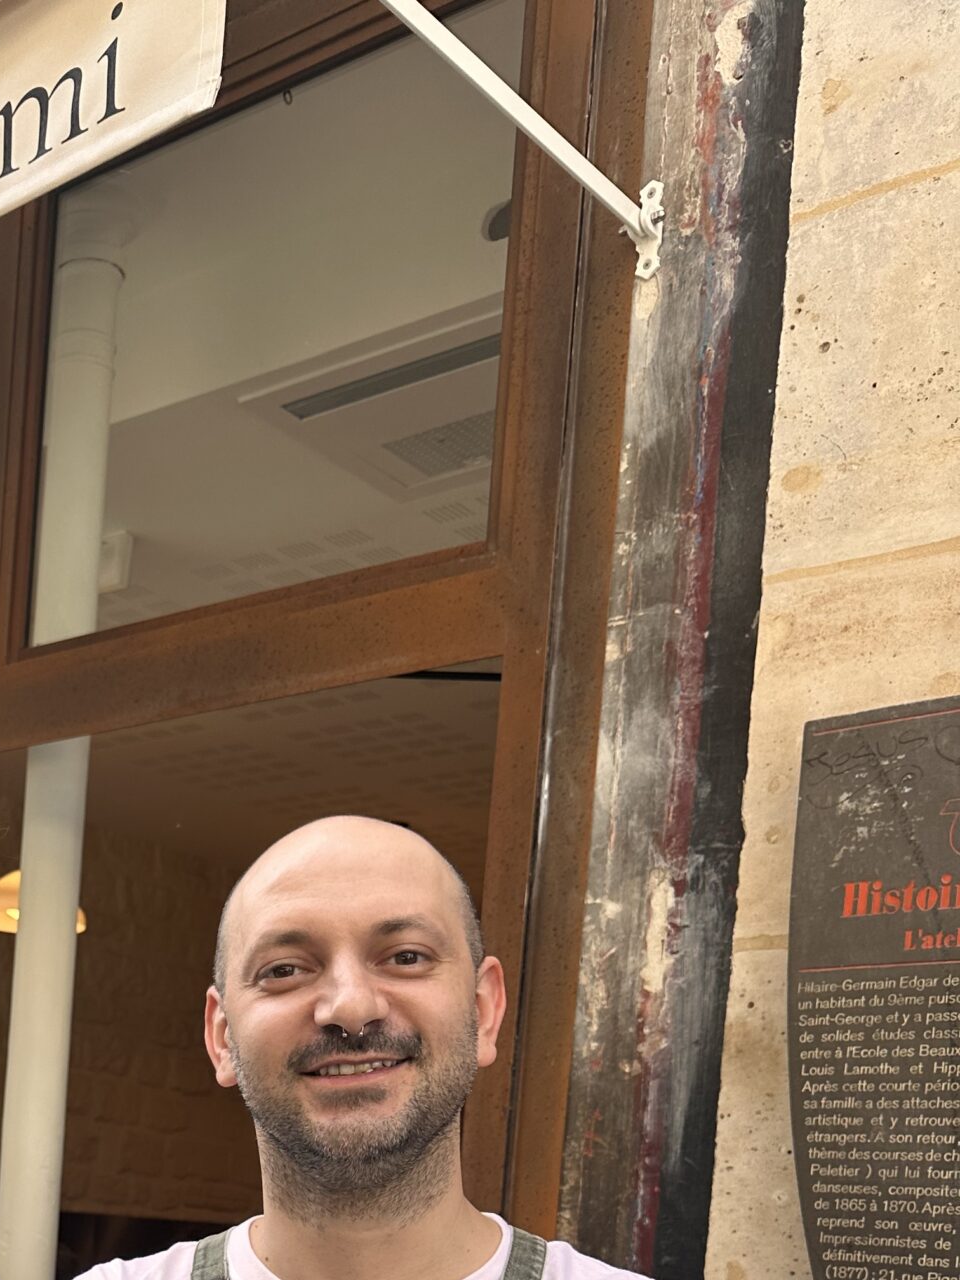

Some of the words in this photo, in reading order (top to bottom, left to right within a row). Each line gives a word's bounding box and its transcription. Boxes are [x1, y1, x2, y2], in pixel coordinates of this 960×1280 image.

[797, 978, 896, 994] Hilaire-Germain
[899, 975, 938, 991] Edgar
[943, 973, 960, 987] de
[798, 1002, 812, 1010] un
[815, 995, 866, 1010] habitant
[869, 995, 885, 1007] du
[887, 993, 925, 1006] 9ème
[798, 1012, 882, 1027] Saint-George
[886, 1012, 899, 1023] et
[902, 1013, 910, 1026] y
[913, 1013, 922, 1022] a
[799, 1032, 815, 1043] de
[821, 1030, 865, 1043] solides
[872, 1028, 916, 1041] études
[800, 1047, 831, 1060] entre
[835, 1046, 843, 1059] à
[892, 1046, 915, 1057] des
[801, 1064, 835, 1076] Louis
[844, 1062, 900, 1075] Lamothe
[909, 1062, 924, 1074] et
[801, 1080, 839, 1096] Après
[842, 1080, 875, 1092] cette
[878, 1080, 921, 1092] courte
[803, 1100, 818, 1109] sa
[820, 1097, 863, 1109] famille
[865, 1099, 873, 1109] a
[876, 1097, 900, 1109] des
[805, 1114, 864, 1129] artistique
[870, 1114, 884, 1126] et
[890, 1115, 898, 1129] y
[806, 1130, 871, 1145] étrangers.
[889, 1133, 913, 1143] son
[808, 1147, 846, 1160] thème
[848, 1148, 871, 1160] des
[872, 1149, 924, 1161] courses
[925, 1149, 941, 1161] de
[810, 1163, 861, 1177] Peletier
[878, 1165, 898, 1180] qui
[905, 1165, 920, 1178] lui
[812, 1181, 882, 1197] danseuses,
[814, 1198, 830, 1210] de
[835, 1198, 867, 1212] 1865
[869, 1199, 878, 1212] à
[883, 1200, 919, 1214] 1870.
[816, 1216, 865, 1230] reprend
[874, 1219, 899, 1230] son
[819, 1231, 927, 1249] Impressionnistes
[934, 1237, 952, 1250] de
[822, 1248, 913, 1266] définitivement
[917, 1253, 950, 1268] dans
